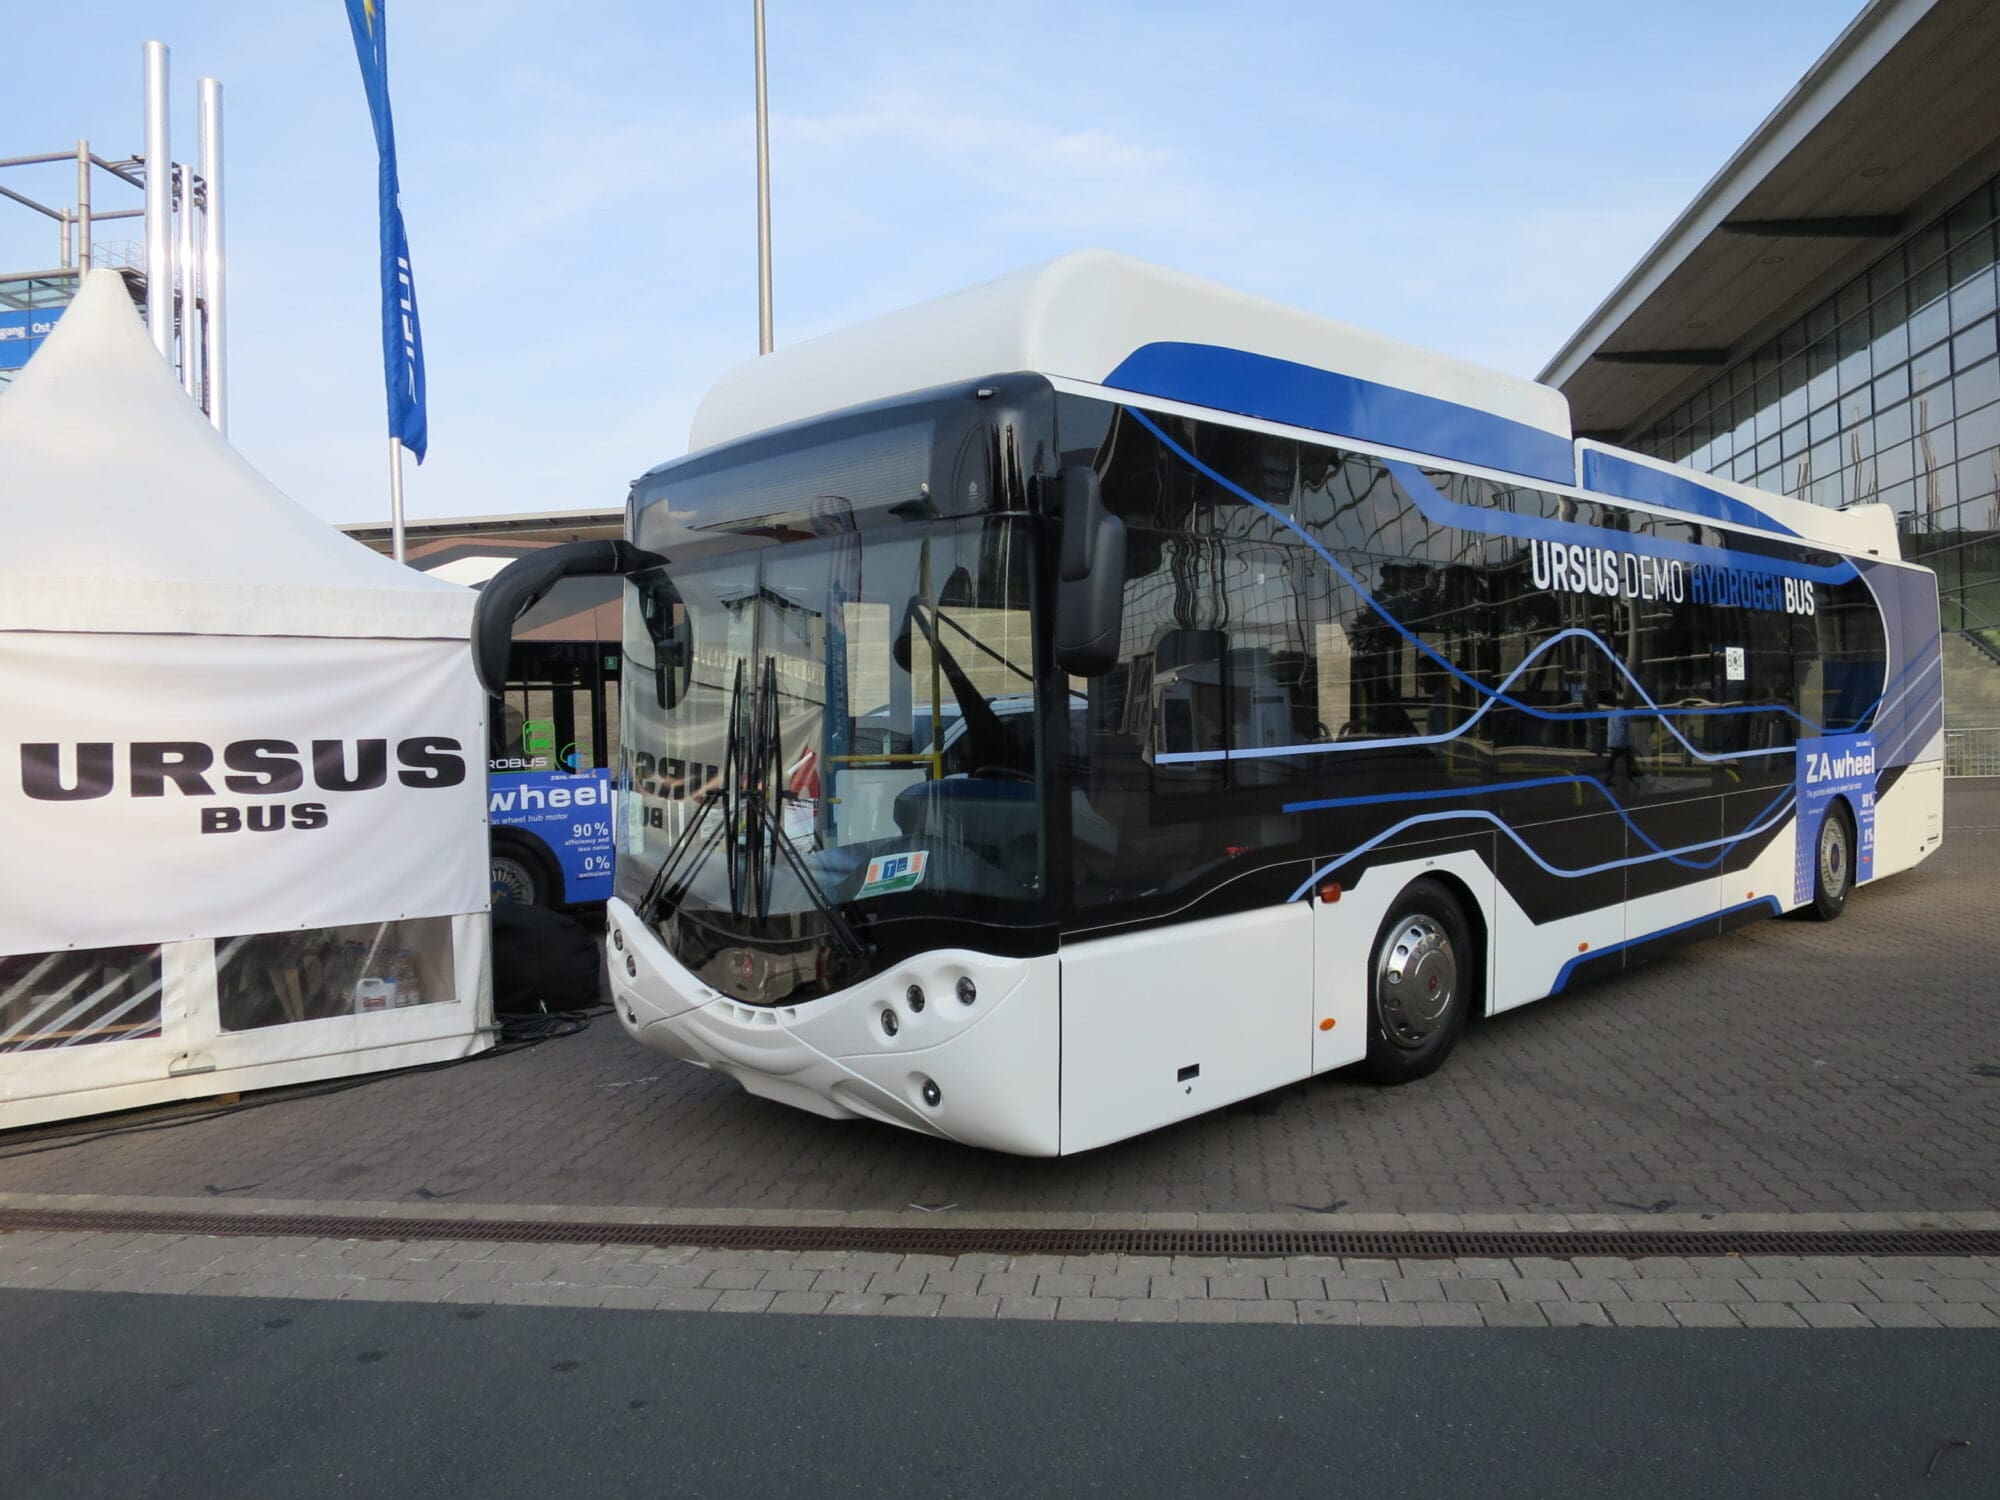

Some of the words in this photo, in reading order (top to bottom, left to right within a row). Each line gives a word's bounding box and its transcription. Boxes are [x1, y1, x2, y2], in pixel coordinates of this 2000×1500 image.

[1531, 539, 1619, 597] URSUS
[1624, 552, 1683, 603] DEMO
[1691, 563, 1784, 612] HYDROGEN
[1785, 577, 1815, 616] BUS
[20, 736, 467, 801] URSUS
[1806, 752, 1832, 784] ZA
[1833, 747, 1875, 779] wheel
[489, 779, 609, 812] wheel
[201, 803, 328, 834] BUS
[502, 814, 526, 824] wheel
[528, 814, 543, 822] hub
[545, 813, 568, 821] motor
[573, 823, 592, 837] 90
[595, 822, 608, 836] %
[584, 857, 594, 870] 0
[596, 856, 610, 869] %
